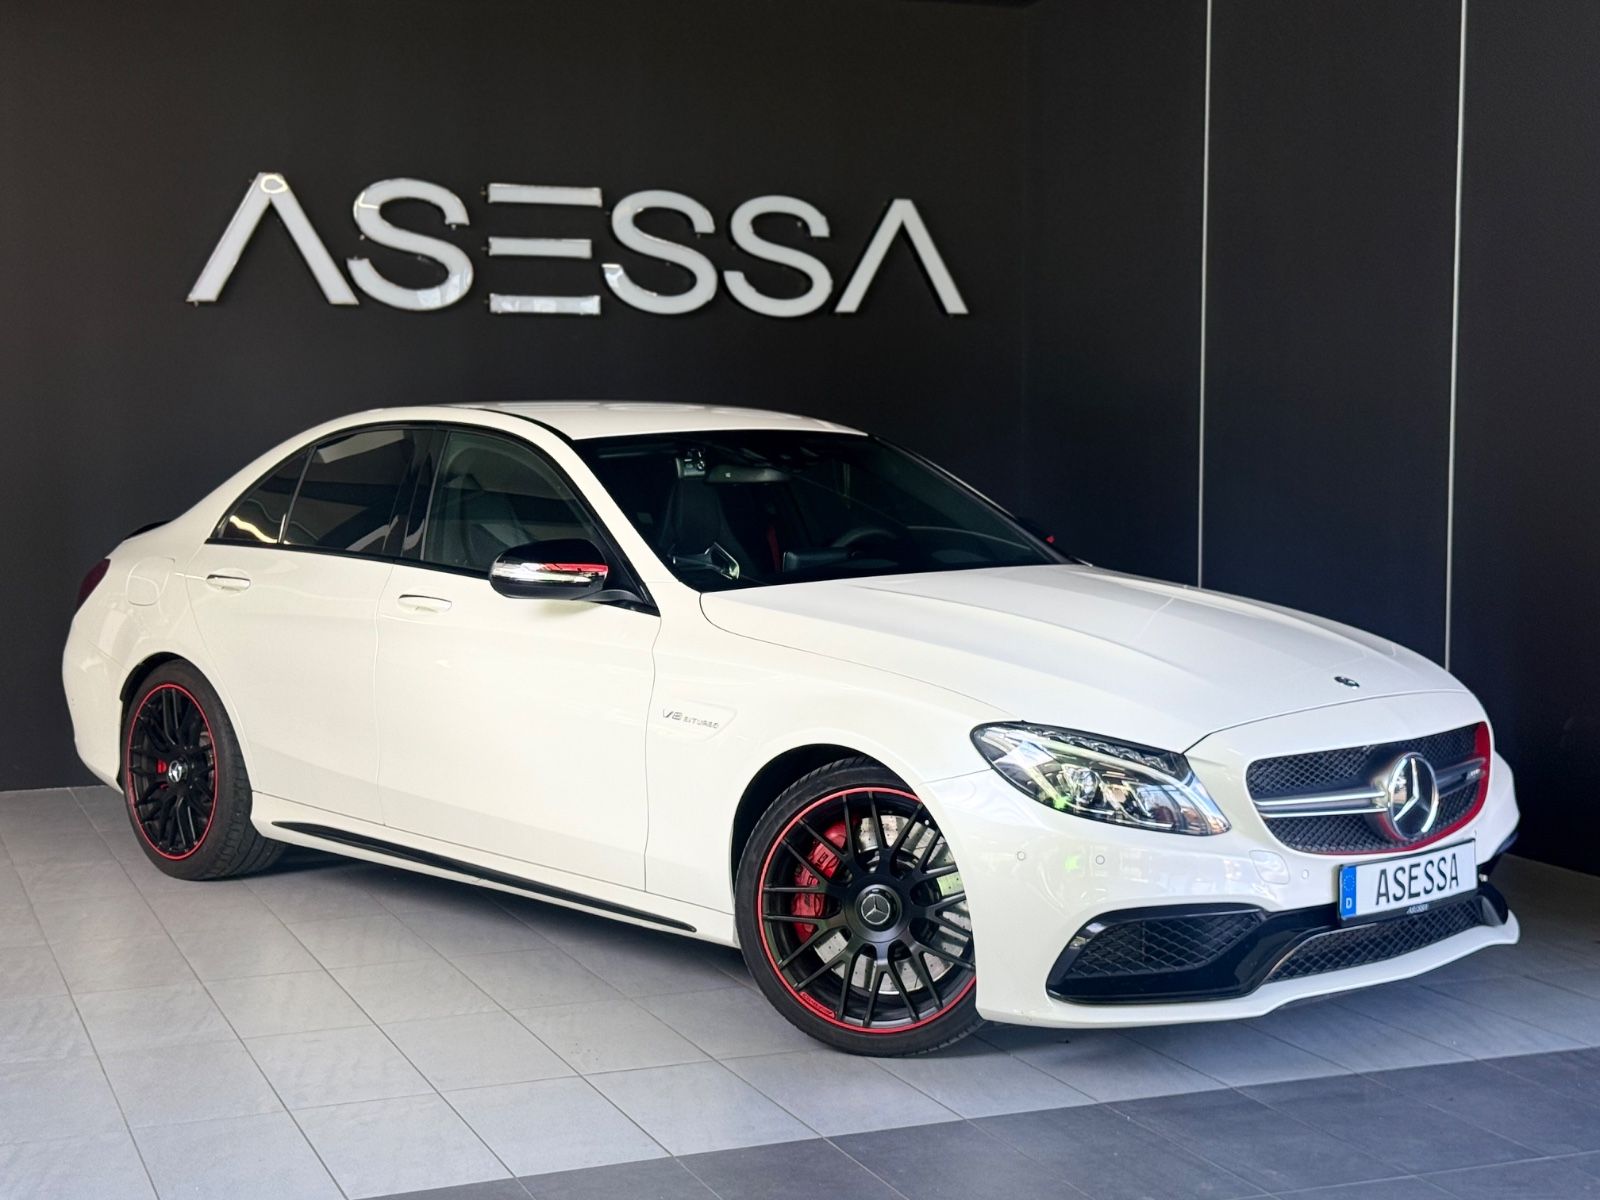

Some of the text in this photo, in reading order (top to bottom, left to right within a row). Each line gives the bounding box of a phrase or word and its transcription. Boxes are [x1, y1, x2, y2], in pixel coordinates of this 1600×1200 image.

[186, 172, 969, 317] ASESSA
[662, 708, 683, 721] V8
[1376, 852, 1459, 905] ASESSA
[1345, 898, 1351, 909] D
